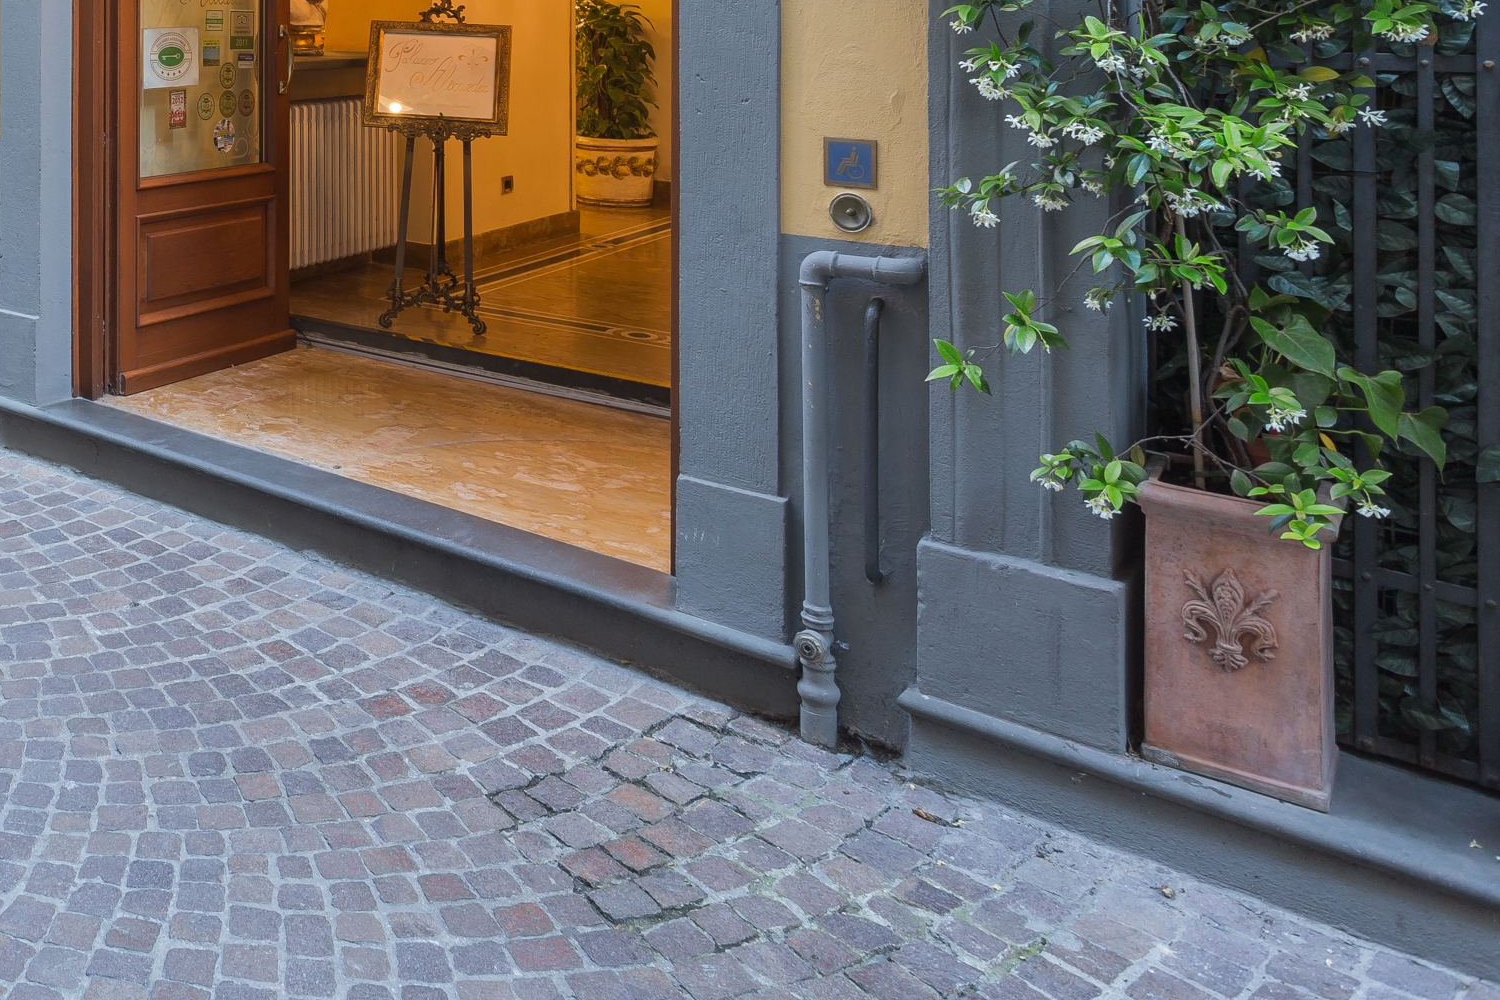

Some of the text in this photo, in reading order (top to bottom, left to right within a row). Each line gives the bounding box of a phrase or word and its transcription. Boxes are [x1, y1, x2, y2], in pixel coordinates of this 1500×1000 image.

[235, 38, 248, 47] 2011
[384, 38, 440, 73] Palazzo
[409, 56, 489, 94] Alexander
[172, 96, 184, 105] 2012
